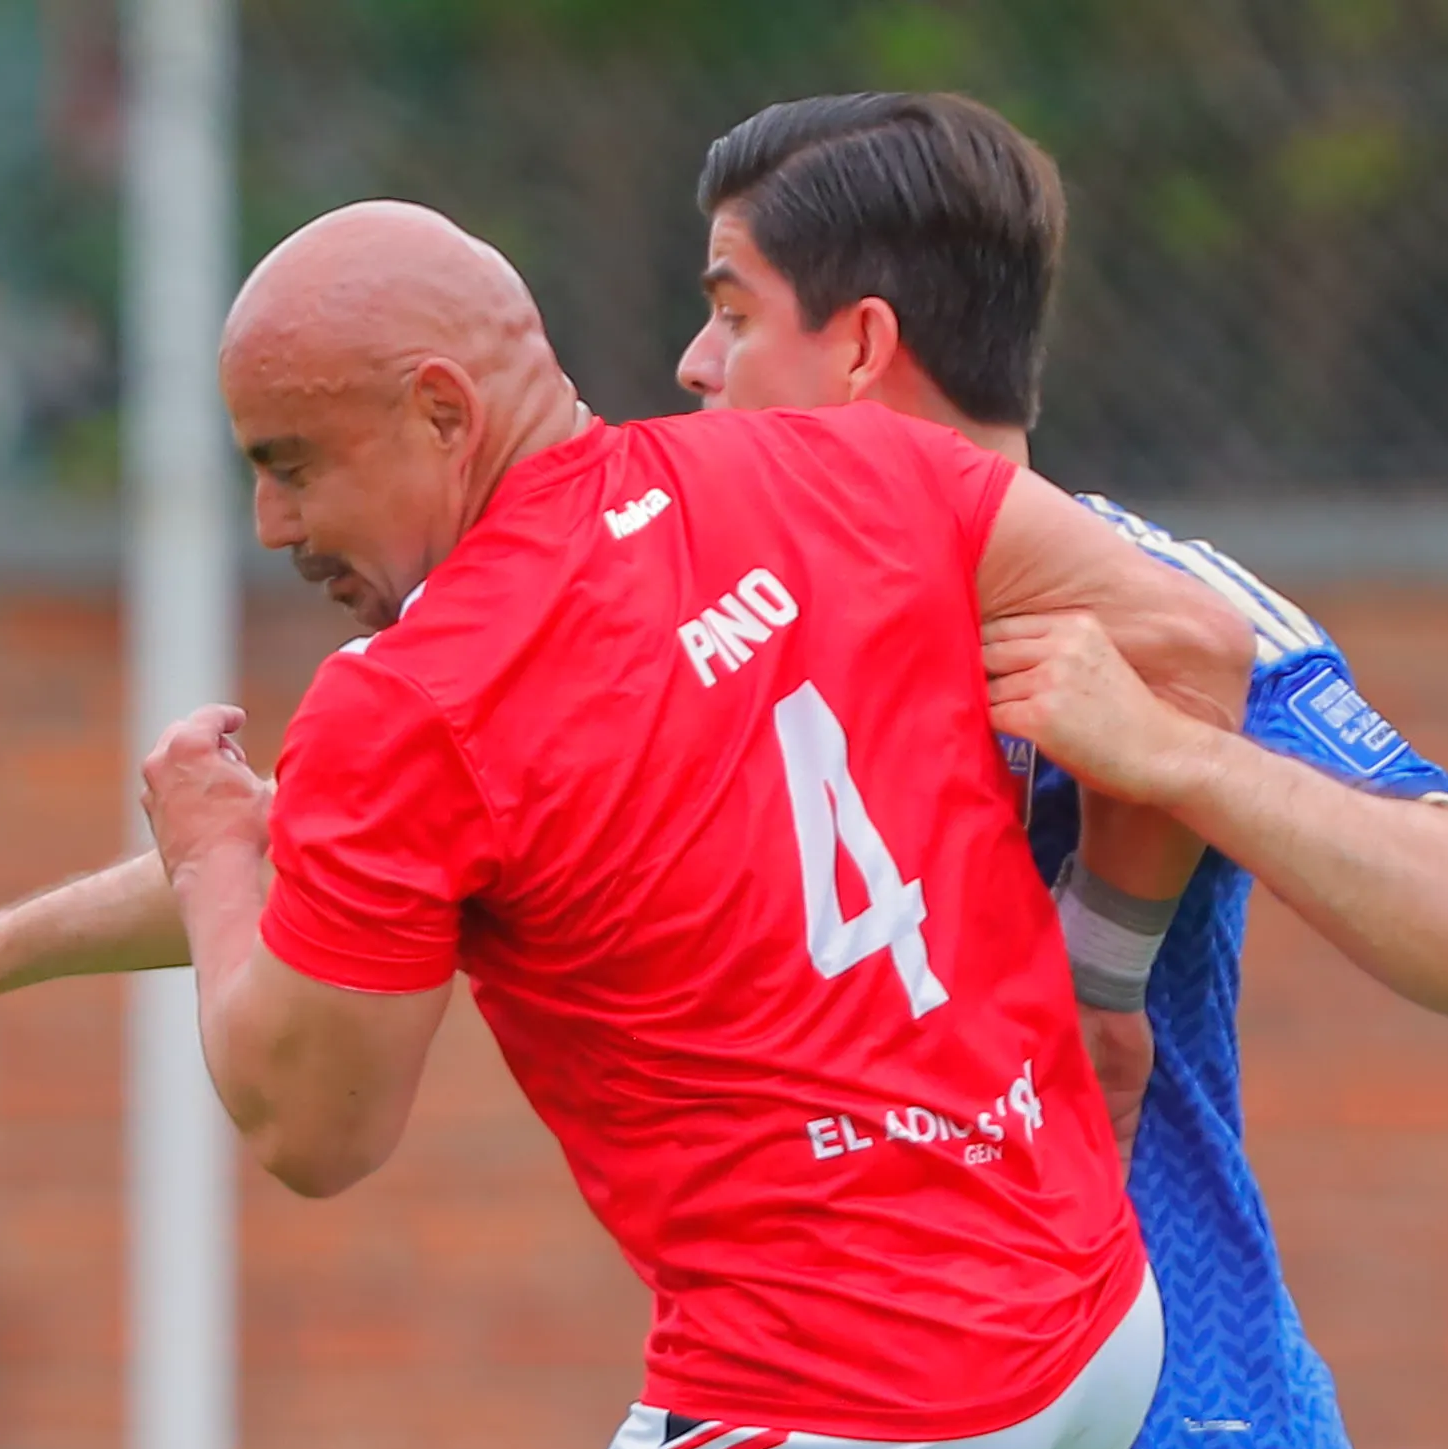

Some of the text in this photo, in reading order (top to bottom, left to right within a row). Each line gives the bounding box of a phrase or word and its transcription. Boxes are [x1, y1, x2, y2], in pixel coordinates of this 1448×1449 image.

[677, 567, 799, 688] PINO
[774, 679, 950, 1020] 4
[806, 1115, 873, 1160] EL
